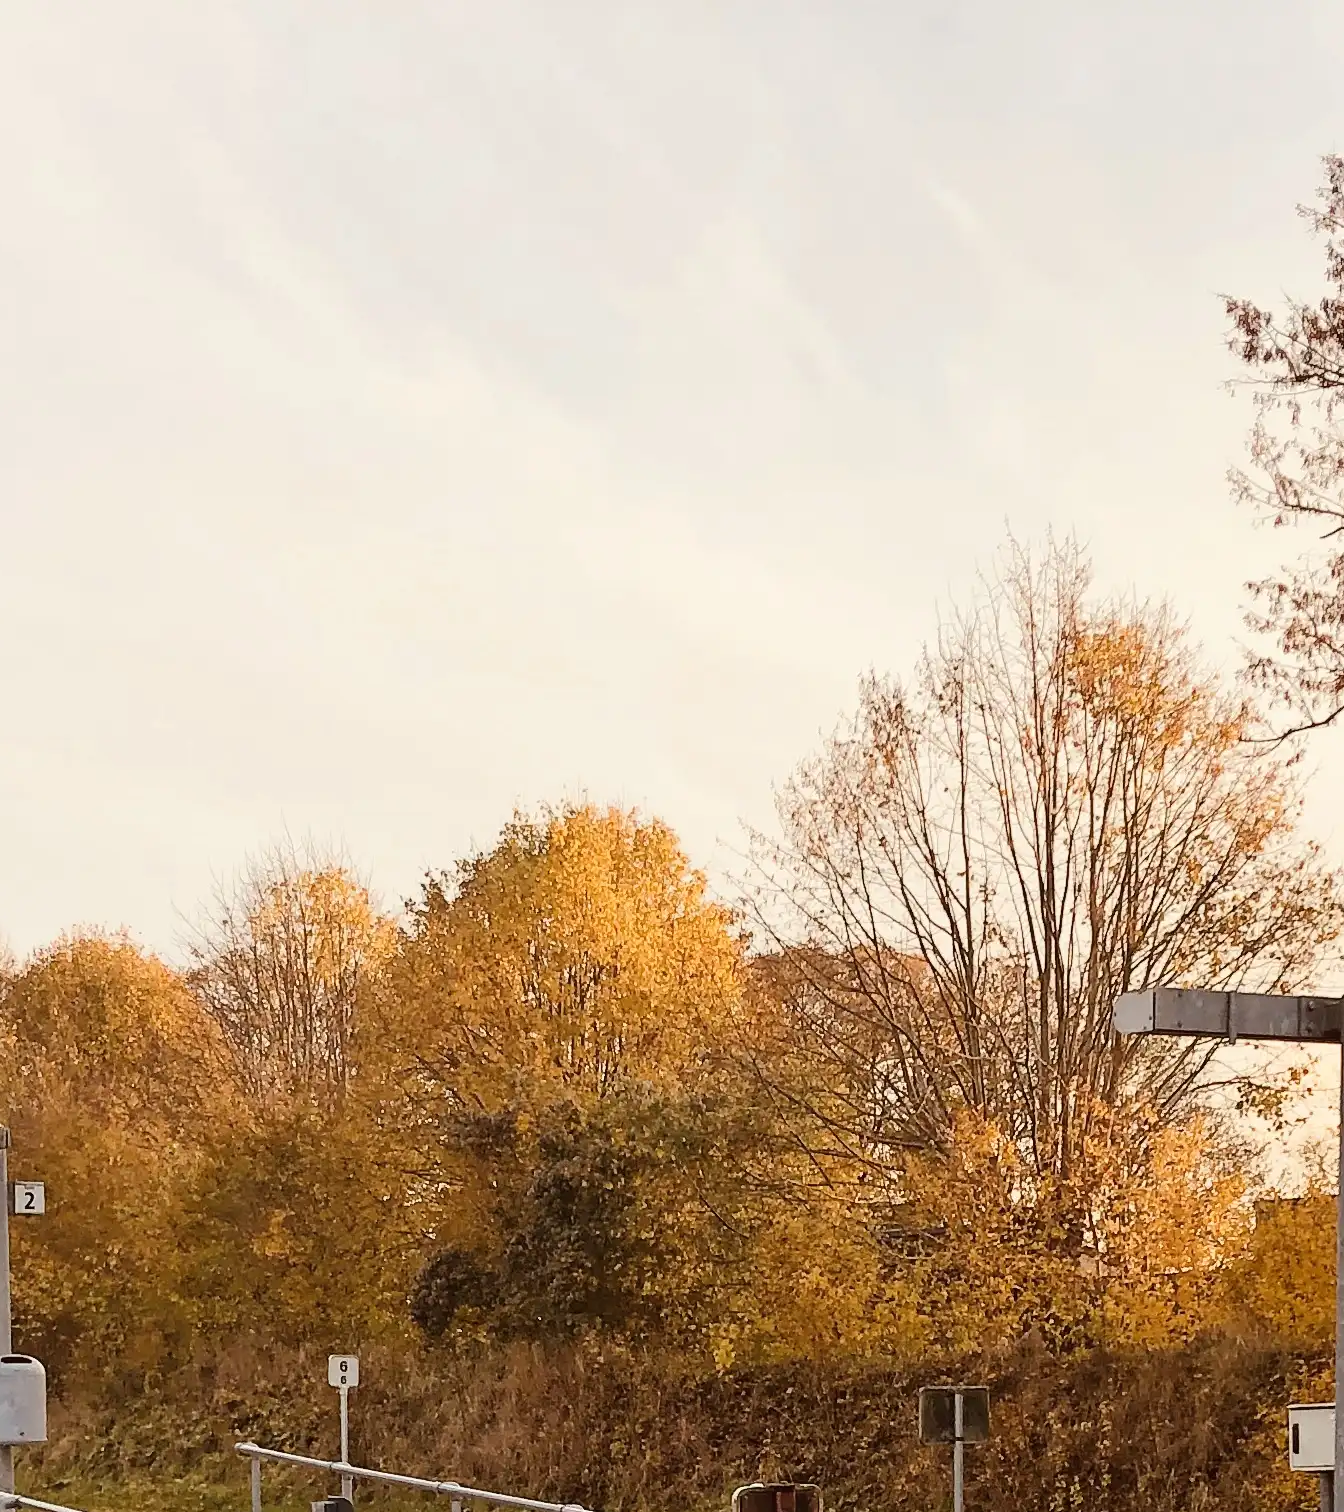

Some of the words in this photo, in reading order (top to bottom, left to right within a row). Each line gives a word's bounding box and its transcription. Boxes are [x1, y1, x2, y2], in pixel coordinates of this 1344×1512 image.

[24, 1191, 36, 1210] 2
[339, 1360, 348, 1373] 6
[340, 1375, 347, 1385] 6
